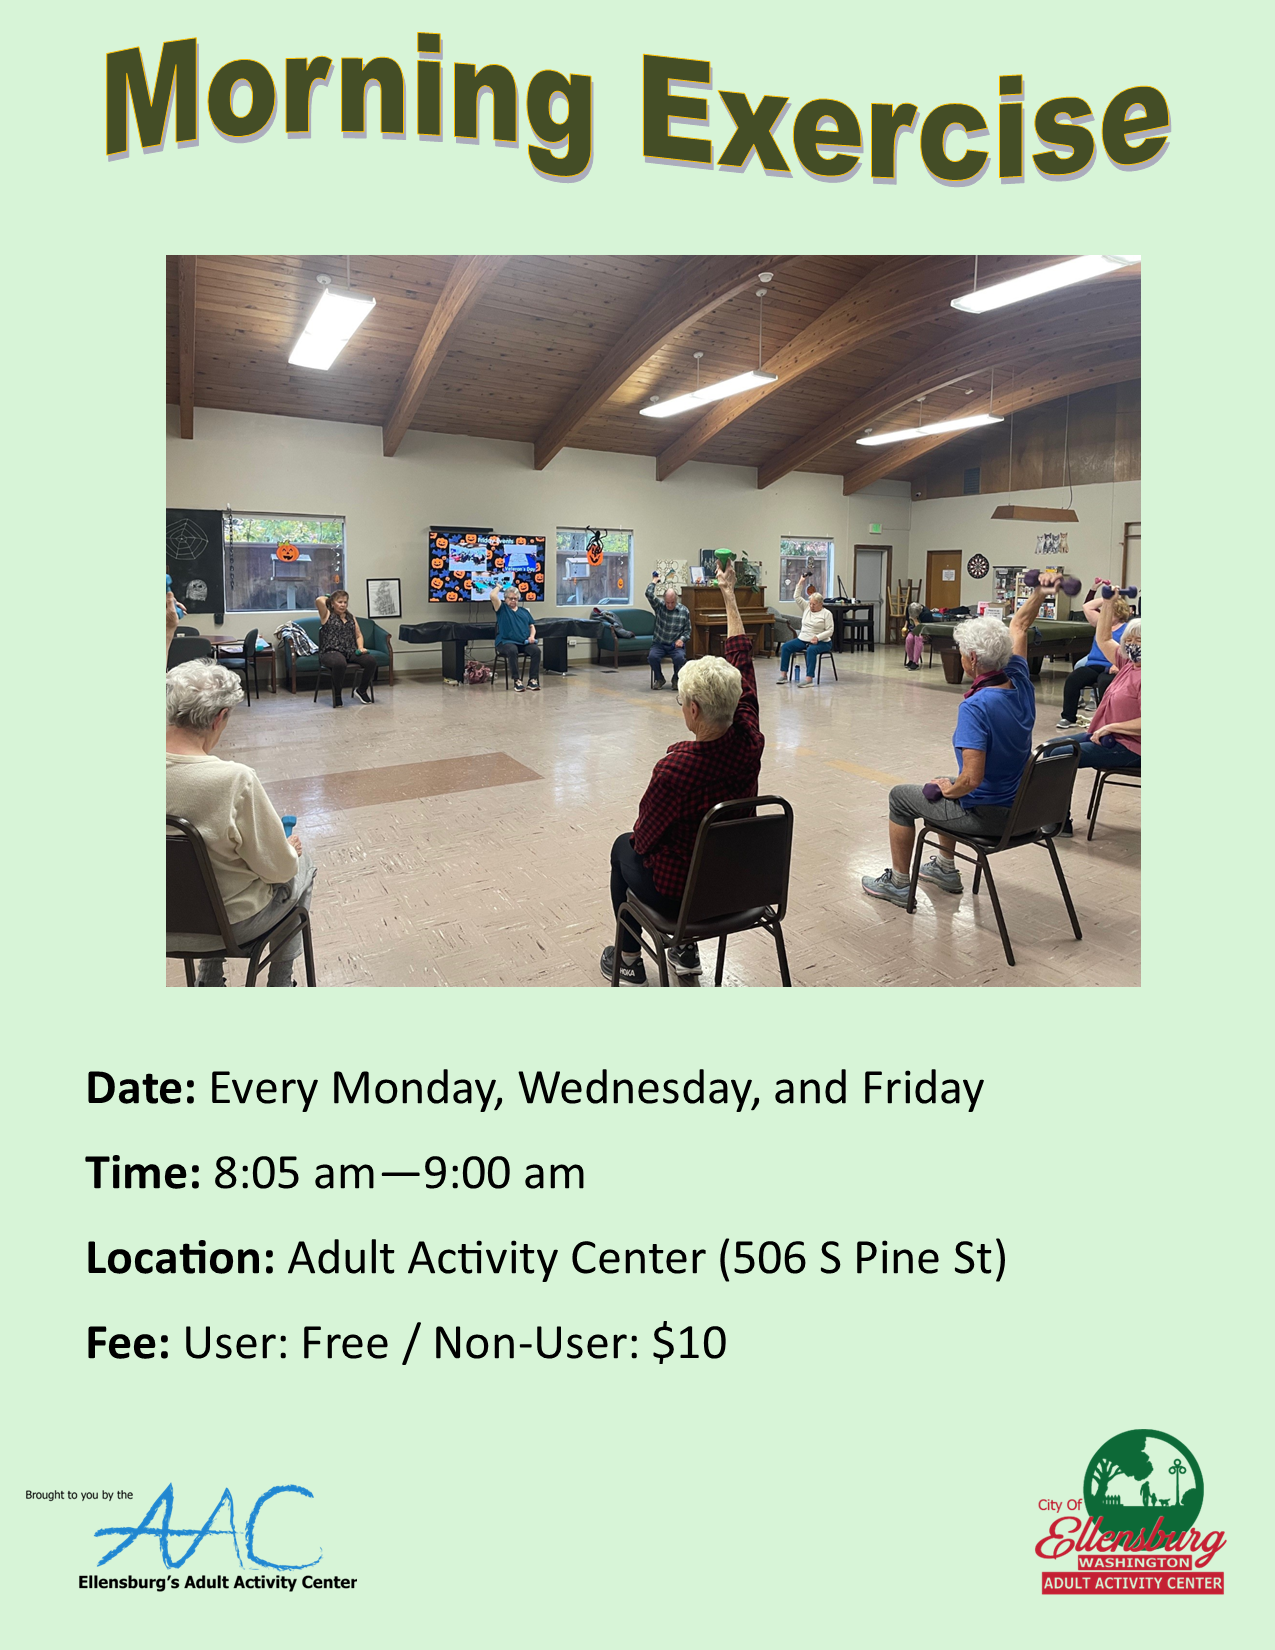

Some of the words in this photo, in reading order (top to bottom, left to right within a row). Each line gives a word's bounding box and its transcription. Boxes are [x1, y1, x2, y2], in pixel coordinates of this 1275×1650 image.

[105, 32, 594, 184] Morning
[642, 53, 1172, 188] Exercise
[620, 968, 635, 977] HOKA
[87, 1070, 195, 1105] Date:
[211, 1070, 319, 1113] Every
[333, 1068, 503, 1113] Monday,
[517, 1068, 760, 1113] Wednesday,
[774, 1068, 847, 1105] and
[864, 1068, 985, 1113] Friday
[84, 1154, 200, 1190] Time:
[214, 1155, 300, 1190] 8:05
[524, 1163, 585, 1190] am
[87, 1239, 274, 1275] Location:
[287, 1238, 396, 1275] Adult
[407, 1239, 559, 1283] Activity
[571, 1240, 707, 1275] Center
[719, 1237, 807, 1283] (506
[820, 1240, 842, 1275] S
[856, 1239, 940, 1275] Pine
[954, 1237, 1006, 1283] St)
[87, 1325, 169, 1360] Fee:
[185, 1325, 287, 1360] User:
[303, 1325, 389, 1360] Free
[401, 1321, 422, 1366] /
[435, 1325, 638, 1360] Non-User:
[652, 1320, 727, 1365] $10
[25, 1489, 65, 1502] Brought
[67, 1490, 78, 1500] to
[80, 1491, 99, 1502] you
[101, 1489, 115, 1502] by
[116, 1489, 134, 1500] the
[1038, 1498, 1063, 1513] City
[1066, 1498, 1083, 1511] Of
[94, 1482, 323, 1572] AAC
[1034, 1515, 1228, 1568] Ellensburg
[1078, 1557, 1190, 1568] WASHINGTON
[183, 1574, 230, 1590] Adult
[233, 1574, 298, 1593] Activity
[301, 1575, 358, 1590] Center
[1044, 1577, 1091, 1590] ADULT
[1095, 1577, 1163, 1590] ACTIVITY
[1167, 1577, 1223, 1590] CENTER
